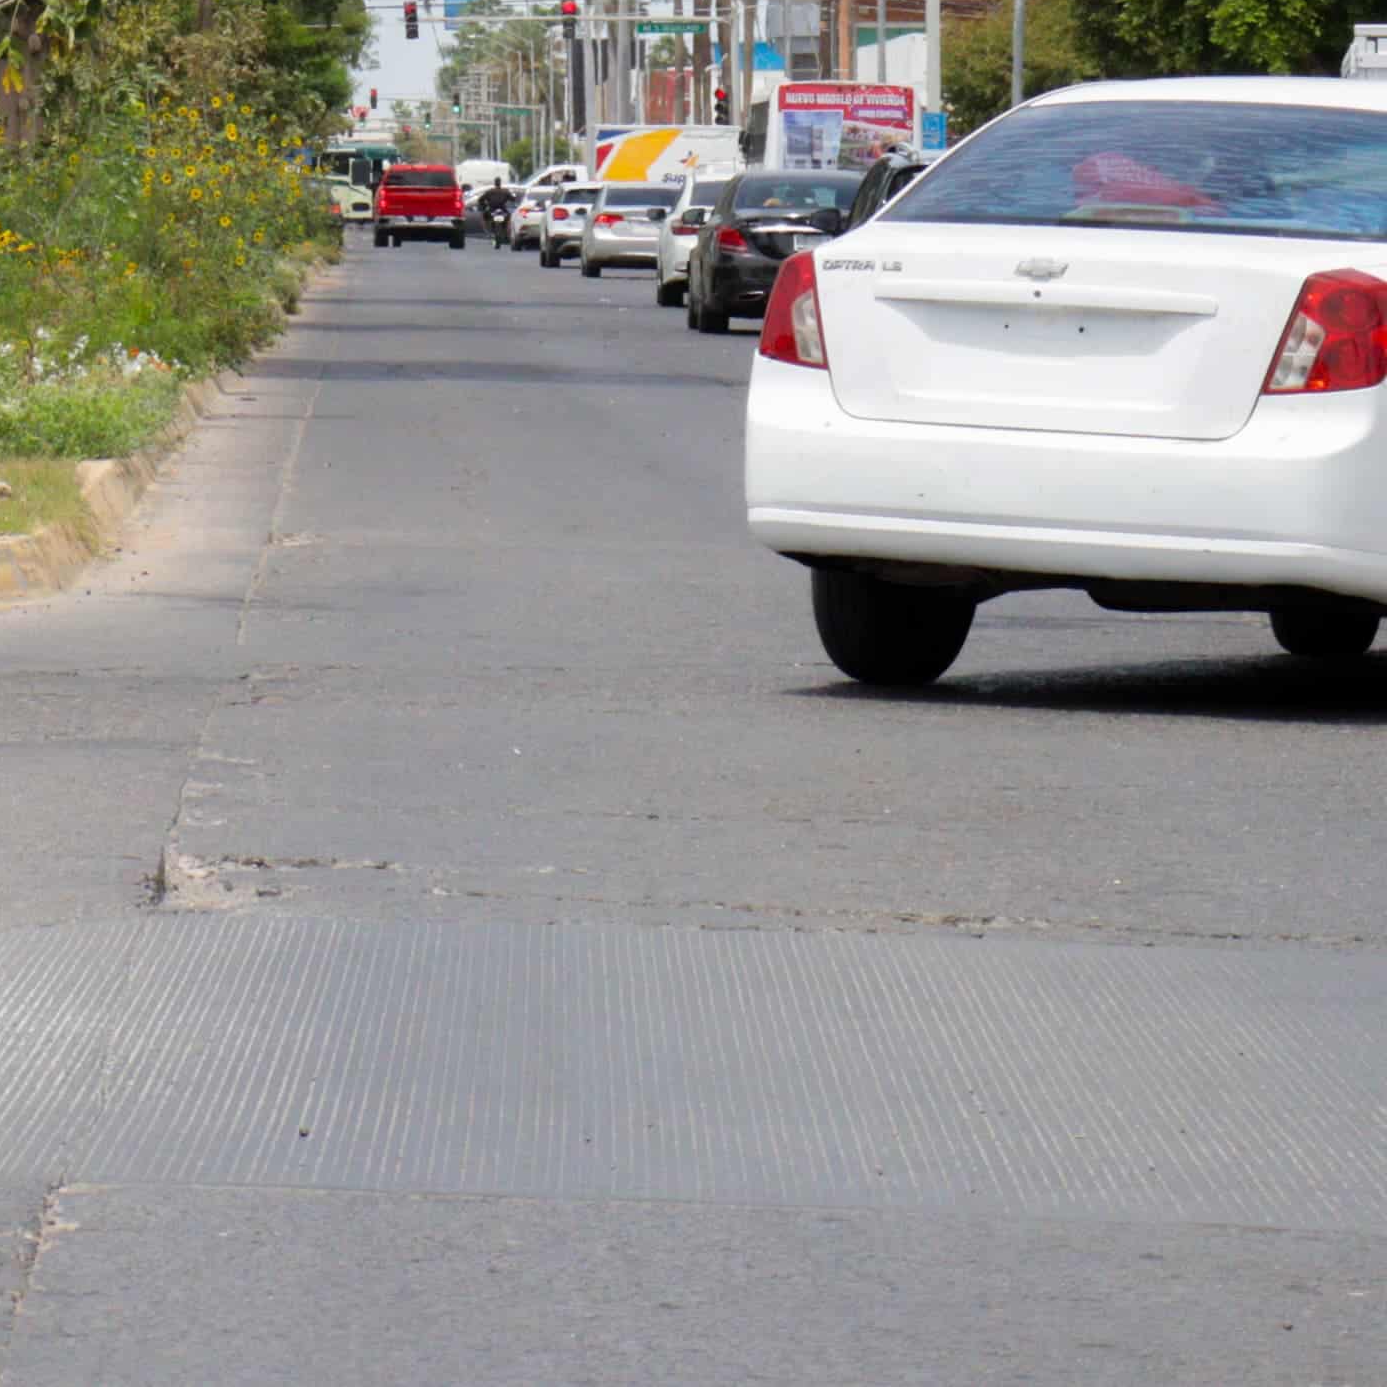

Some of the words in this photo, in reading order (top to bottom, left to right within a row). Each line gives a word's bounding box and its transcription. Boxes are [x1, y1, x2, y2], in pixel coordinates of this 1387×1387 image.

[785, 92, 814, 104] NUEVO
[816, 93, 851, 105] MODELO
[853, 94, 865, 105] DE
[867, 94, 906, 106] VIVIENDA
